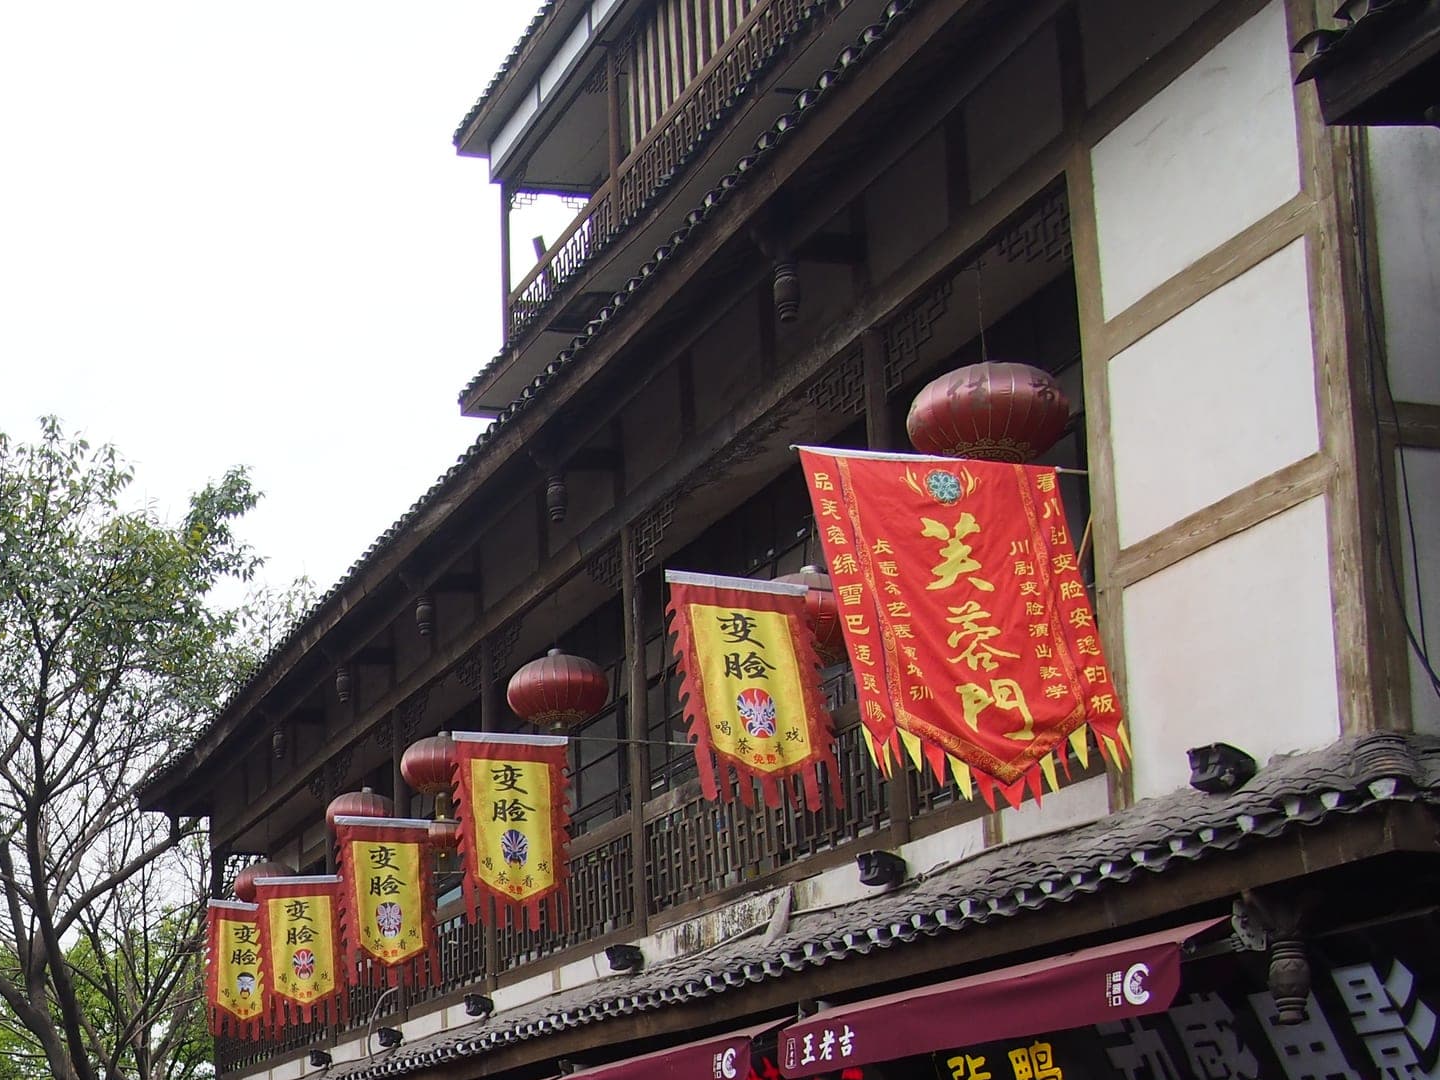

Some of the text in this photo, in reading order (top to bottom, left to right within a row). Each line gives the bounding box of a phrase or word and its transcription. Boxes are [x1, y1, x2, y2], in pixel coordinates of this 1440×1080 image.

[716, 611, 777, 681] 变脸
[752, 753, 777, 765] 免费
[490, 764, 537, 823] 变脸
[368, 845, 407, 897] 变脸
[230, 924, 258, 966] 变脸
[284, 900, 320, 946] 变脸
[800, 1024, 855, 1066] 王老吉
